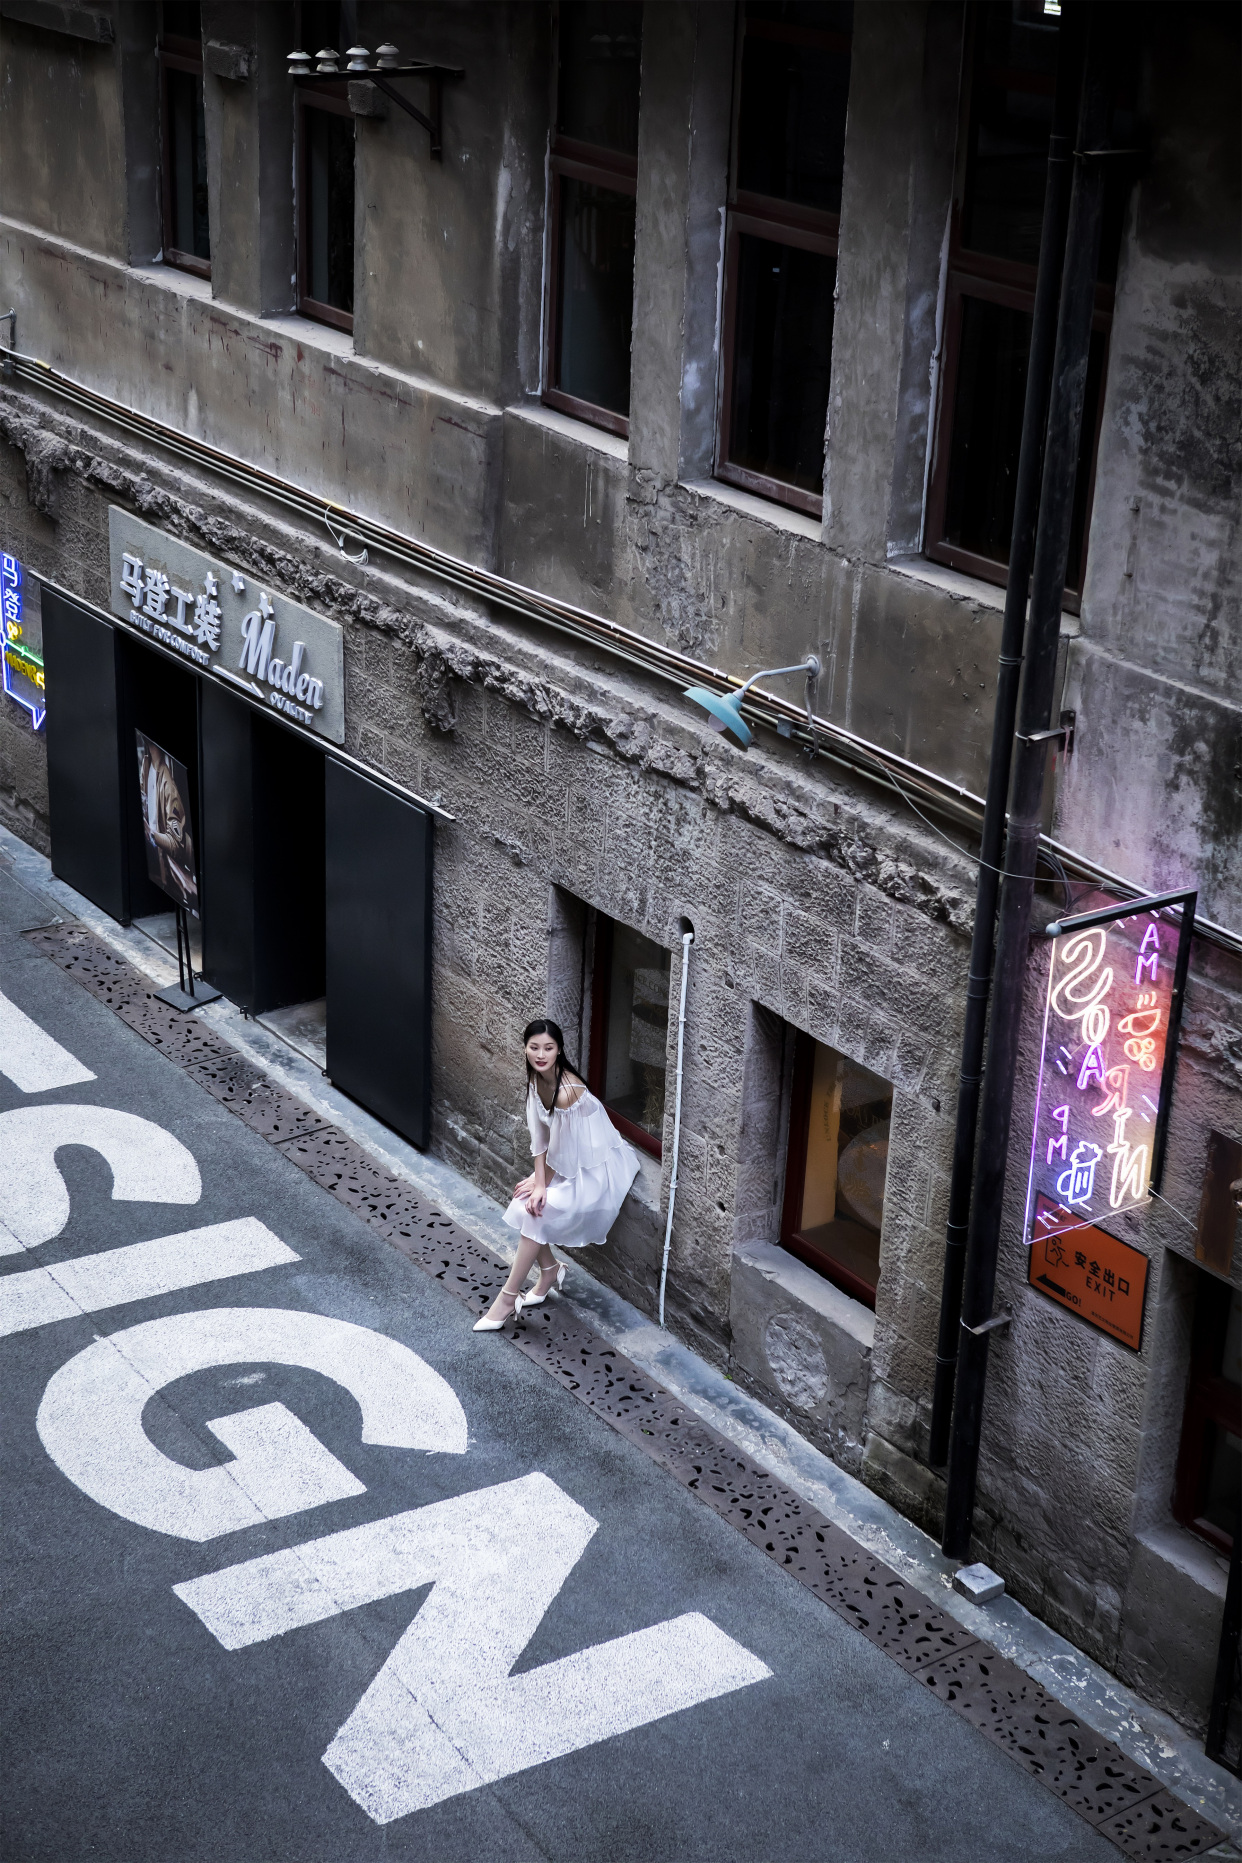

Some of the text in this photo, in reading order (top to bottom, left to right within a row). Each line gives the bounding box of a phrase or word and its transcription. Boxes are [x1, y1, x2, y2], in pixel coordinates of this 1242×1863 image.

[119, 552, 222, 652] 马登工装
[129, 609, 210, 666] BUILT FOR COMFORT
[238, 610, 324, 709] Maden
[269, 691, 314, 725] QUALITY
[1073, 1250, 1130, 1296] 安全出口
[1086, 1276, 1116, 1302] EXIT
[1066, 1291, 1082, 1308] GO!
